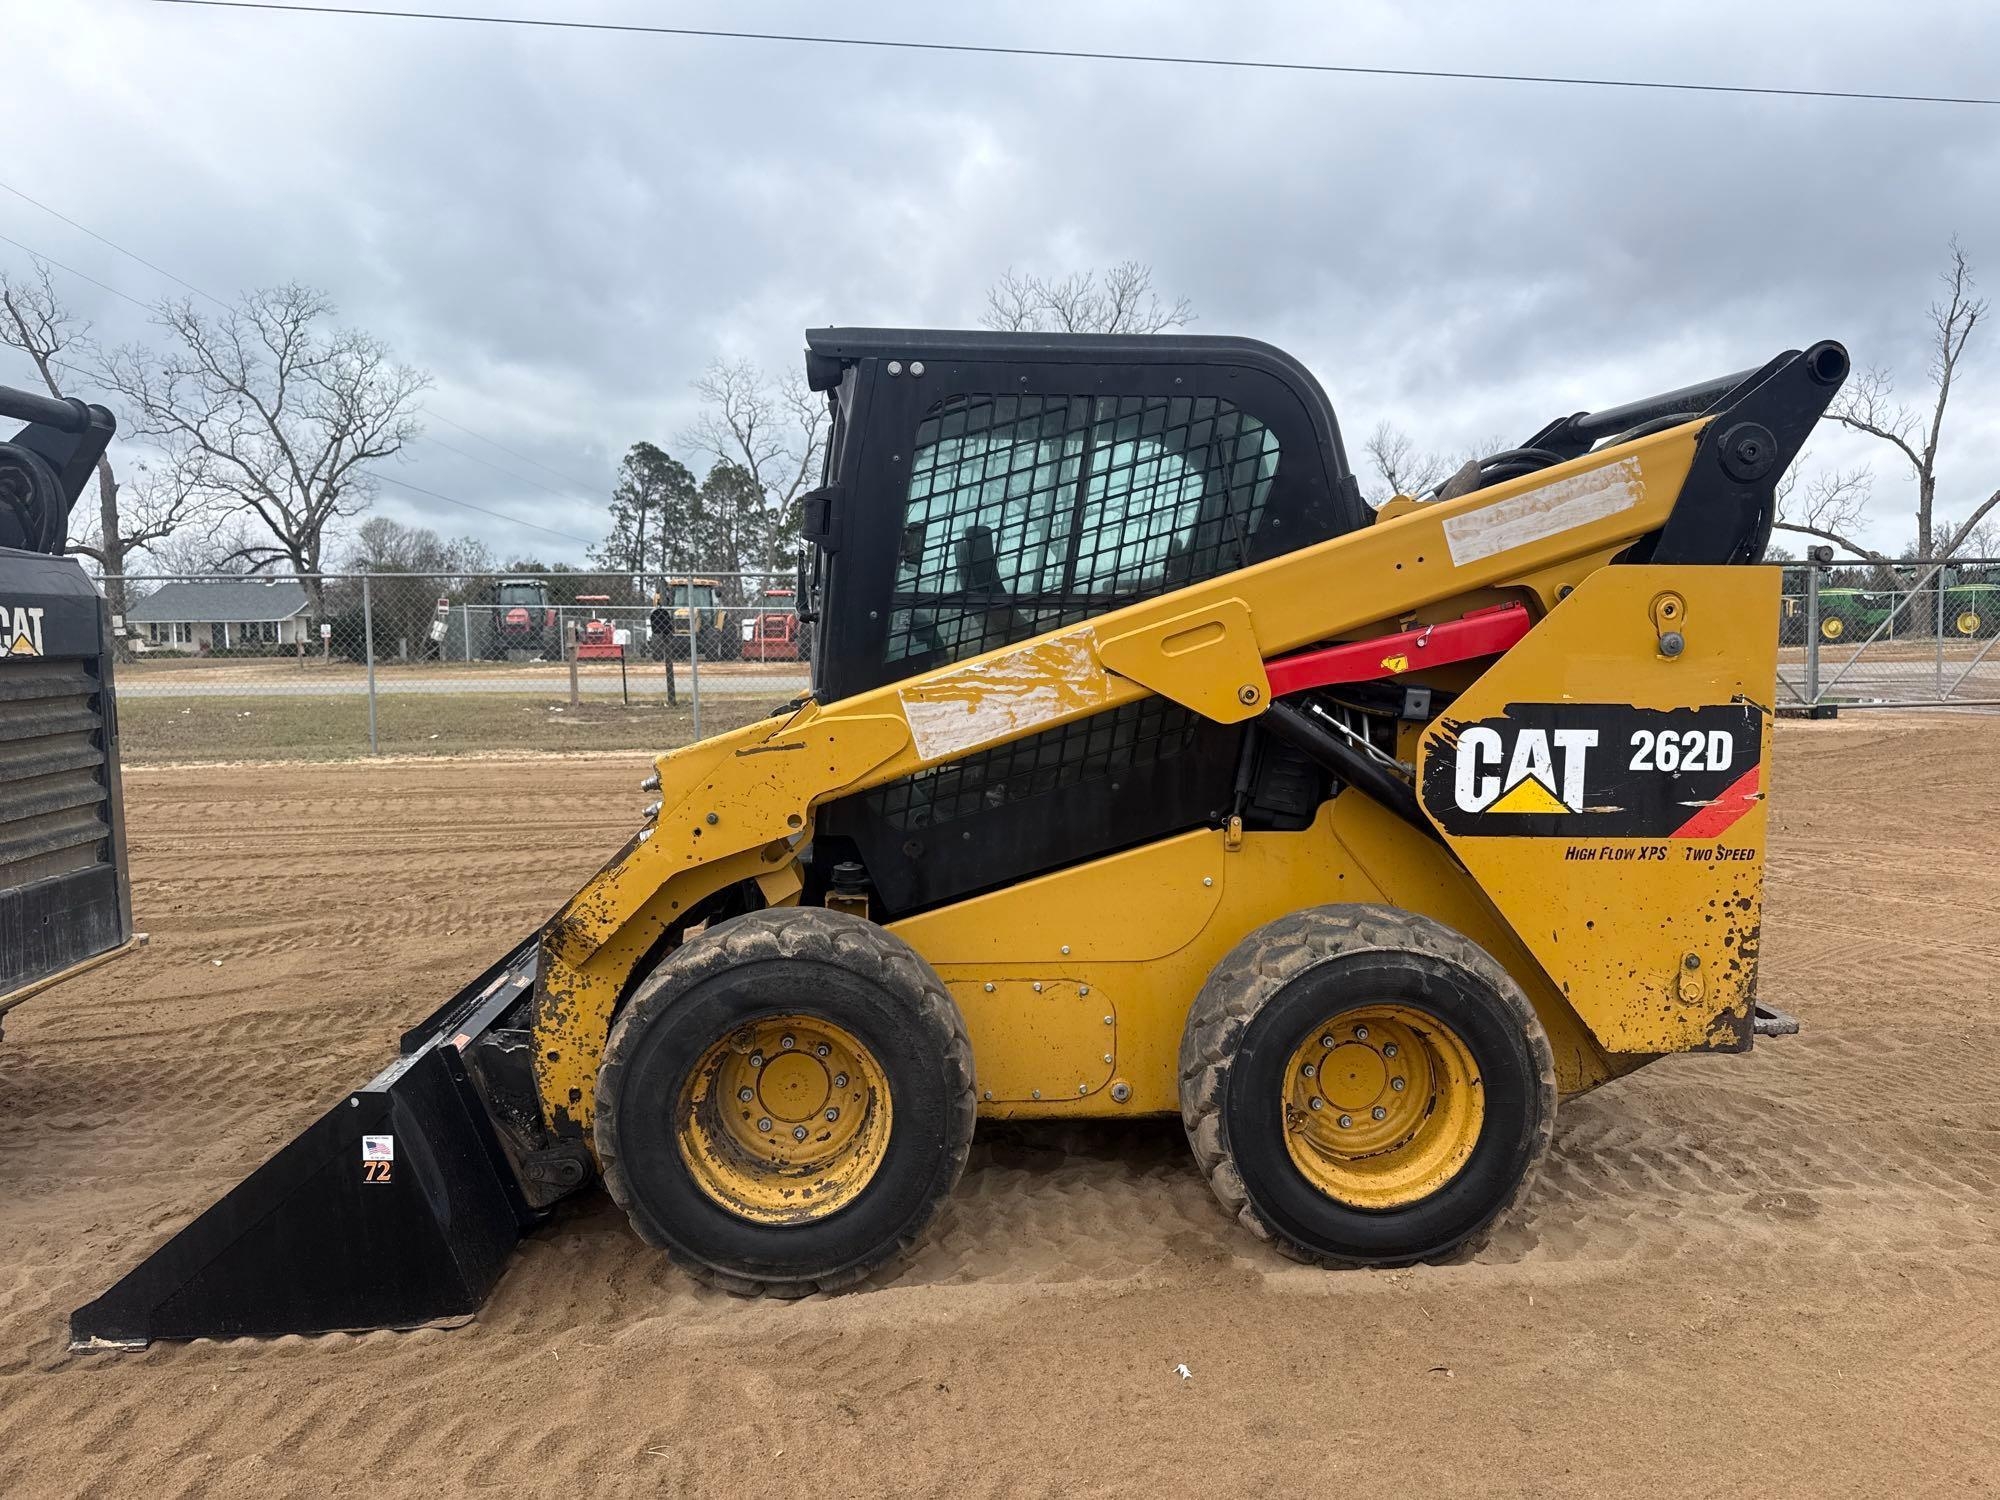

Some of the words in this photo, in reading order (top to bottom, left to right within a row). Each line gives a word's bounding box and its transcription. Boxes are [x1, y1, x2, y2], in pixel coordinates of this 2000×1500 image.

[1628, 729, 1734, 772] 262D
[1454, 726, 1599, 814] CAT
[1565, 846, 1597, 861] HIGH
[1599, 846, 1637, 861] FLOW
[1637, 846, 1668, 861] XPS
[1685, 846, 1713, 861] TWO
[1715, 846, 1756, 862] SPEED
[363, 1161, 392, 1181] 72
